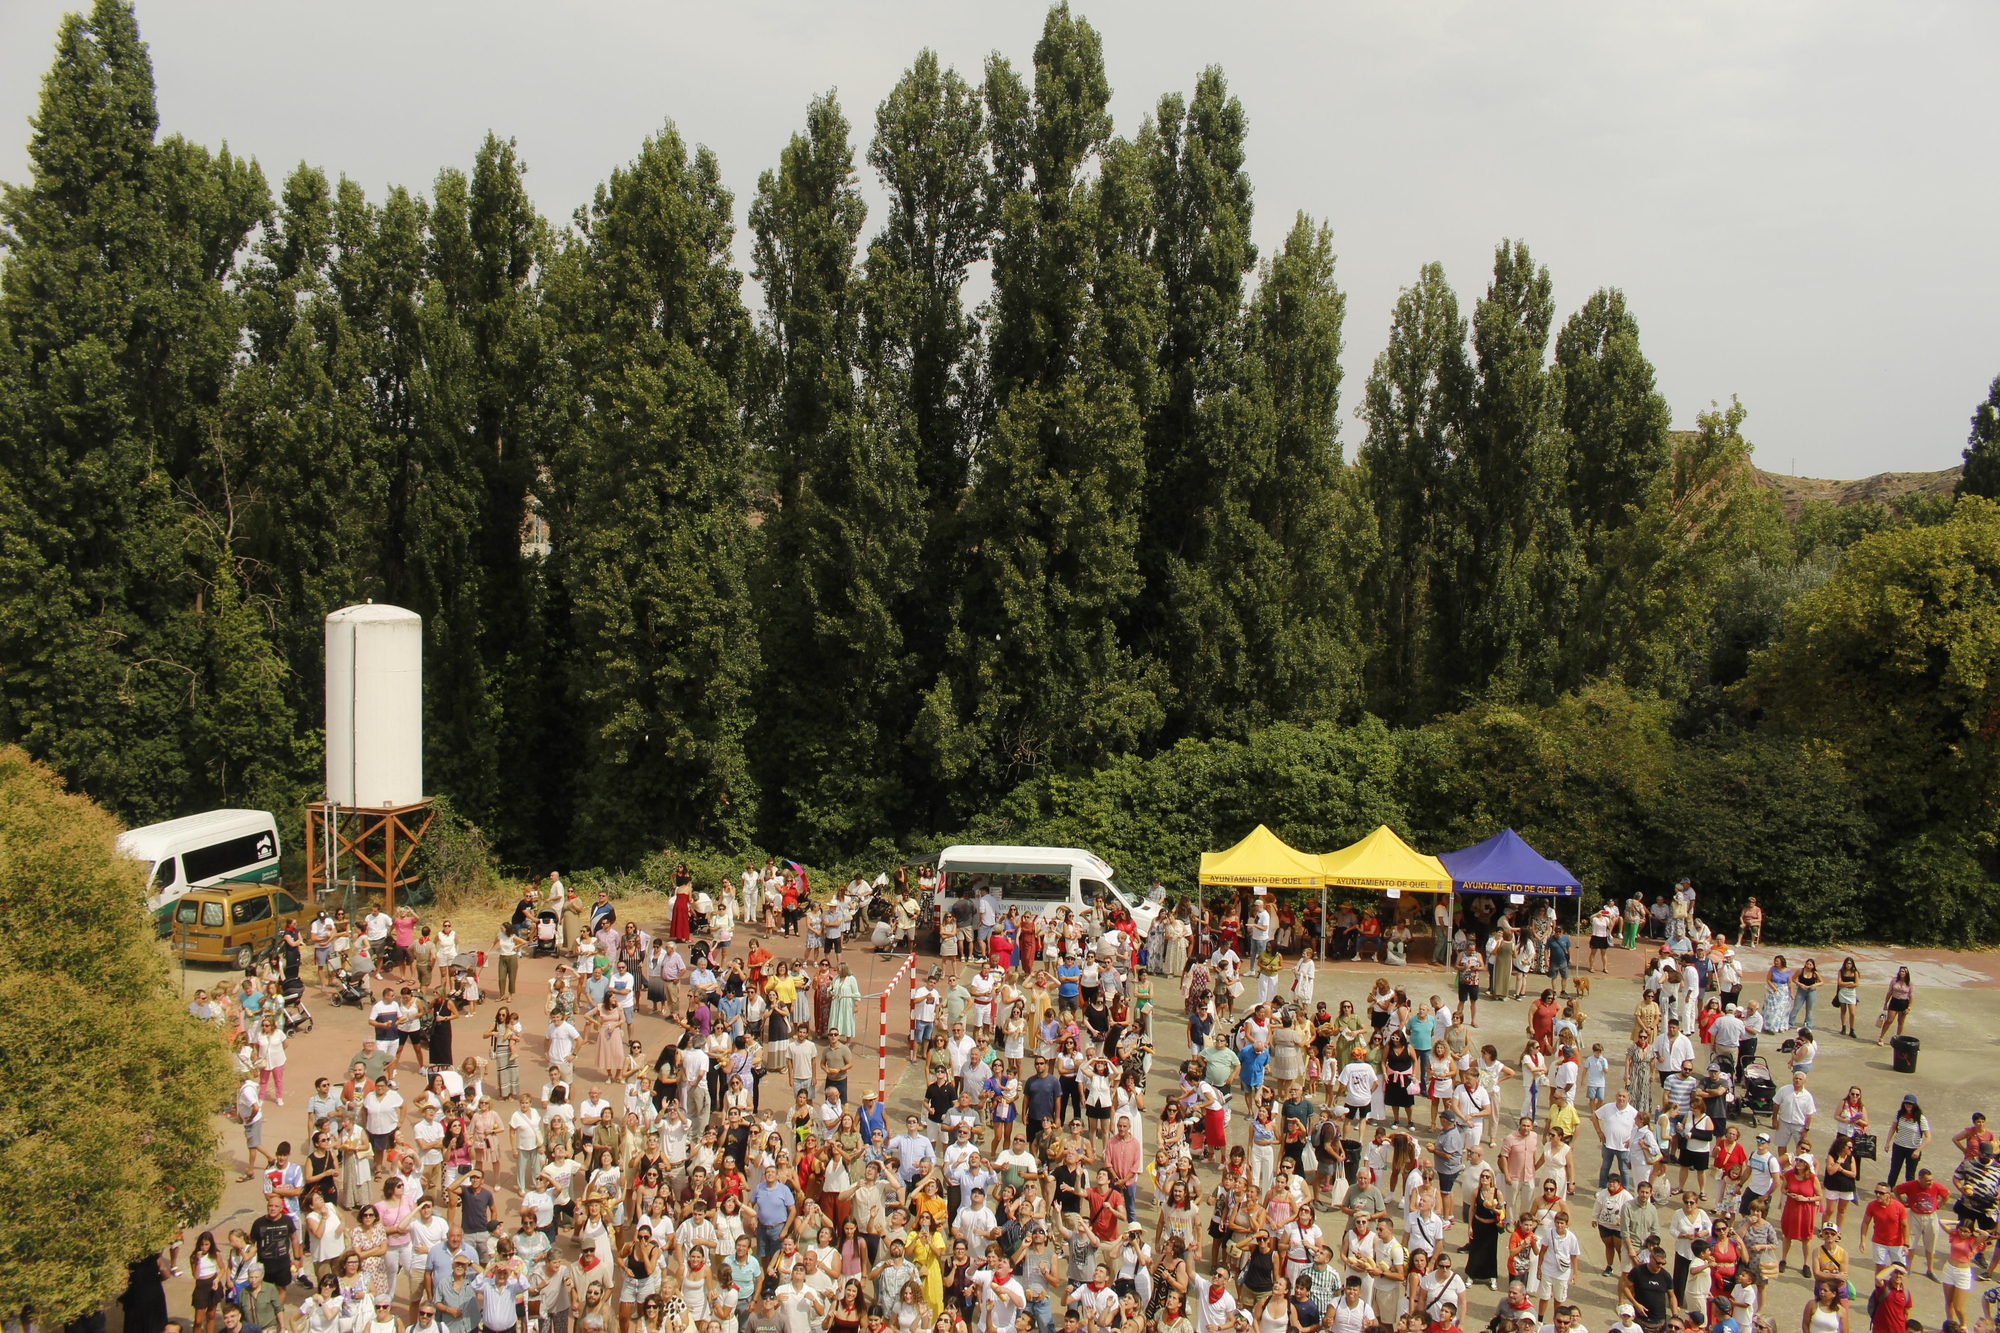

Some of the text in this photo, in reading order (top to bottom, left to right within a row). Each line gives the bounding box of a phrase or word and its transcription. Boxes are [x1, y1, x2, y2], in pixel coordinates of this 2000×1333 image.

[1209, 875, 1303, 885] AYUNTAMIENTO DE QUEL
[1336, 878, 1430, 889] AYUNTAMIENTO DE QUEL
[1462, 881, 1558, 894] AYUNTAMIENTO DE QUEL
